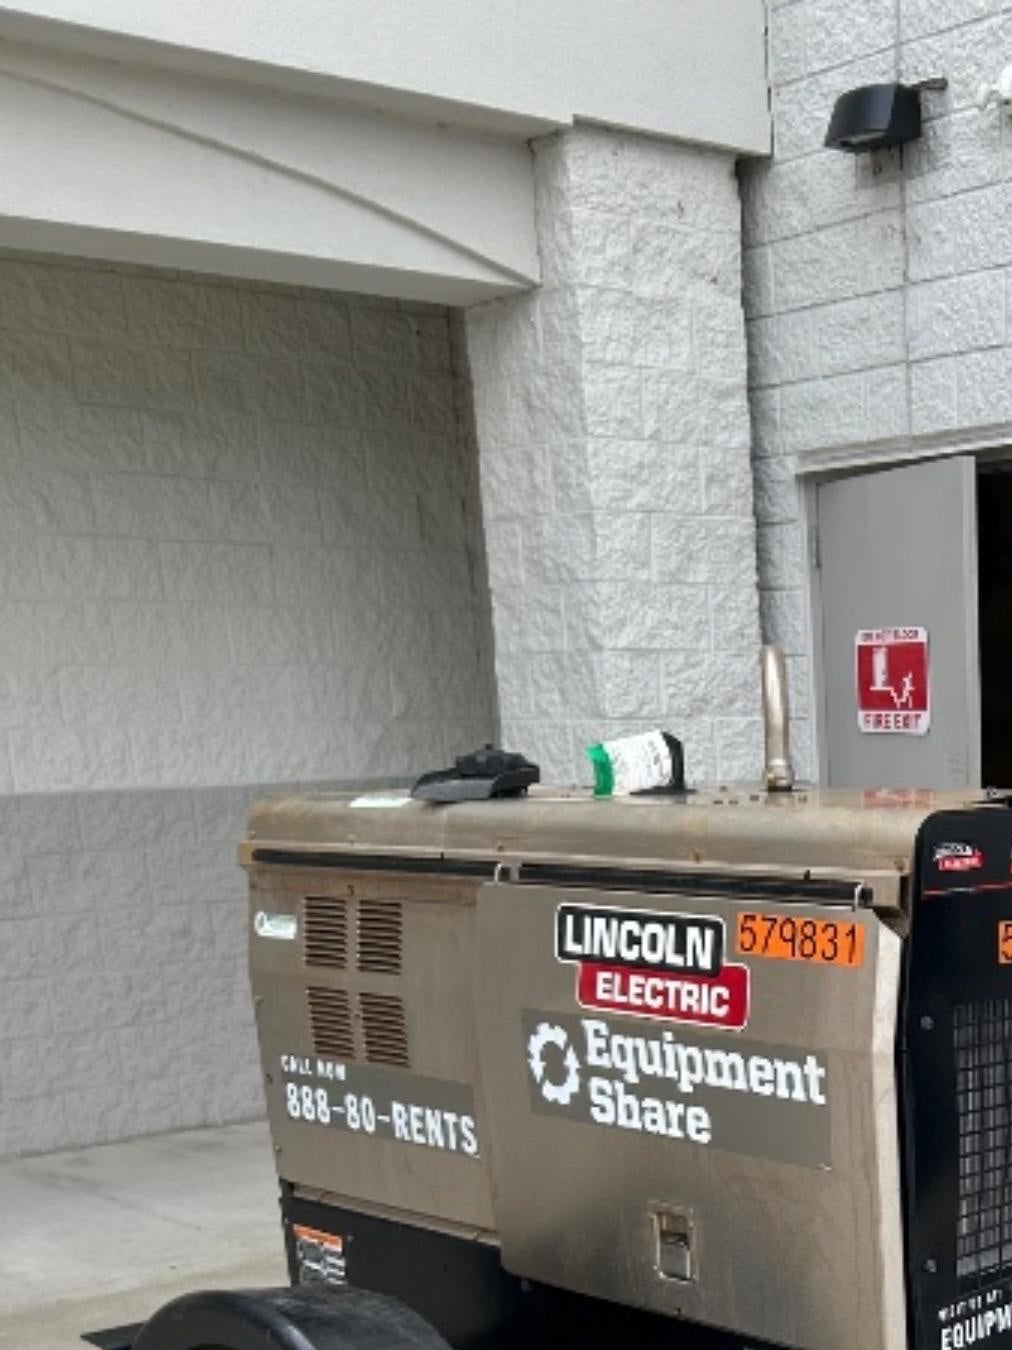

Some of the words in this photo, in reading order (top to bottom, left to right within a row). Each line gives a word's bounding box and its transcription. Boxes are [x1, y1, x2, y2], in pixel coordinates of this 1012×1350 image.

[563, 914, 714, 969] LINCOLN
[739, 914, 858, 964] 579831
[596, 971, 730, 1017] ELECTRIC
[581, 1019, 826, 1104] Equipment
[286, 1082, 478, 1154] 888-80-RENTS
[588, 1077, 712, 1144] Share
